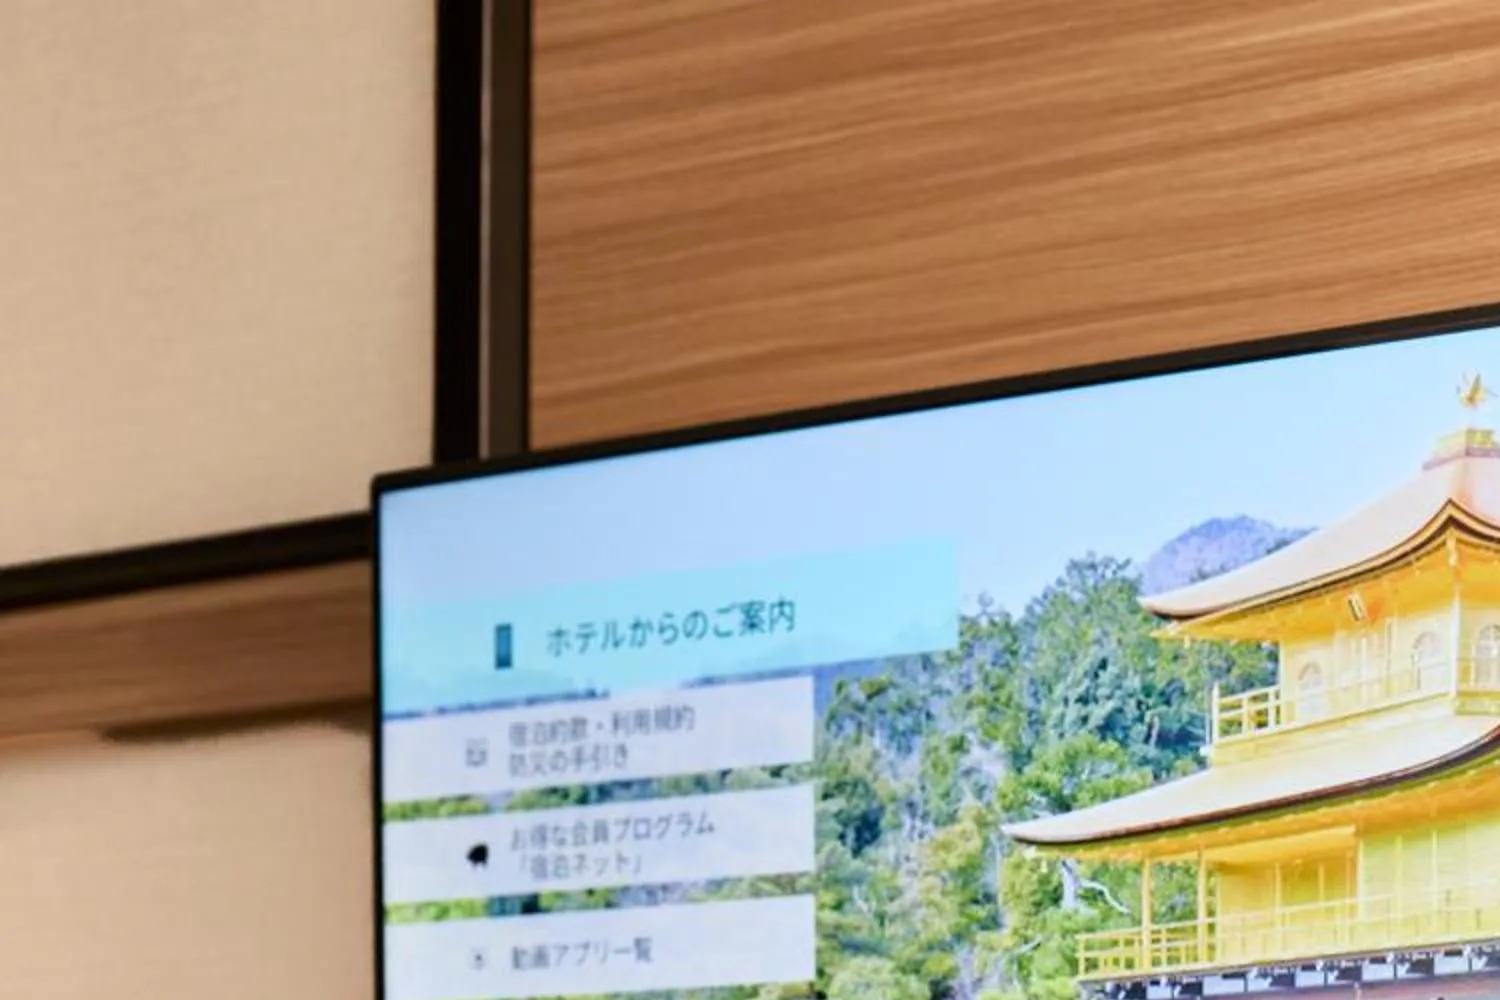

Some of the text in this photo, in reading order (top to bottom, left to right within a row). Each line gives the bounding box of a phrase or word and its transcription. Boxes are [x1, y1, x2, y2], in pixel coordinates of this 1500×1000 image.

[547, 598, 795, 657] ホテルからのご案内
[512, 938, 653, 971] 動画アプリ一覧
